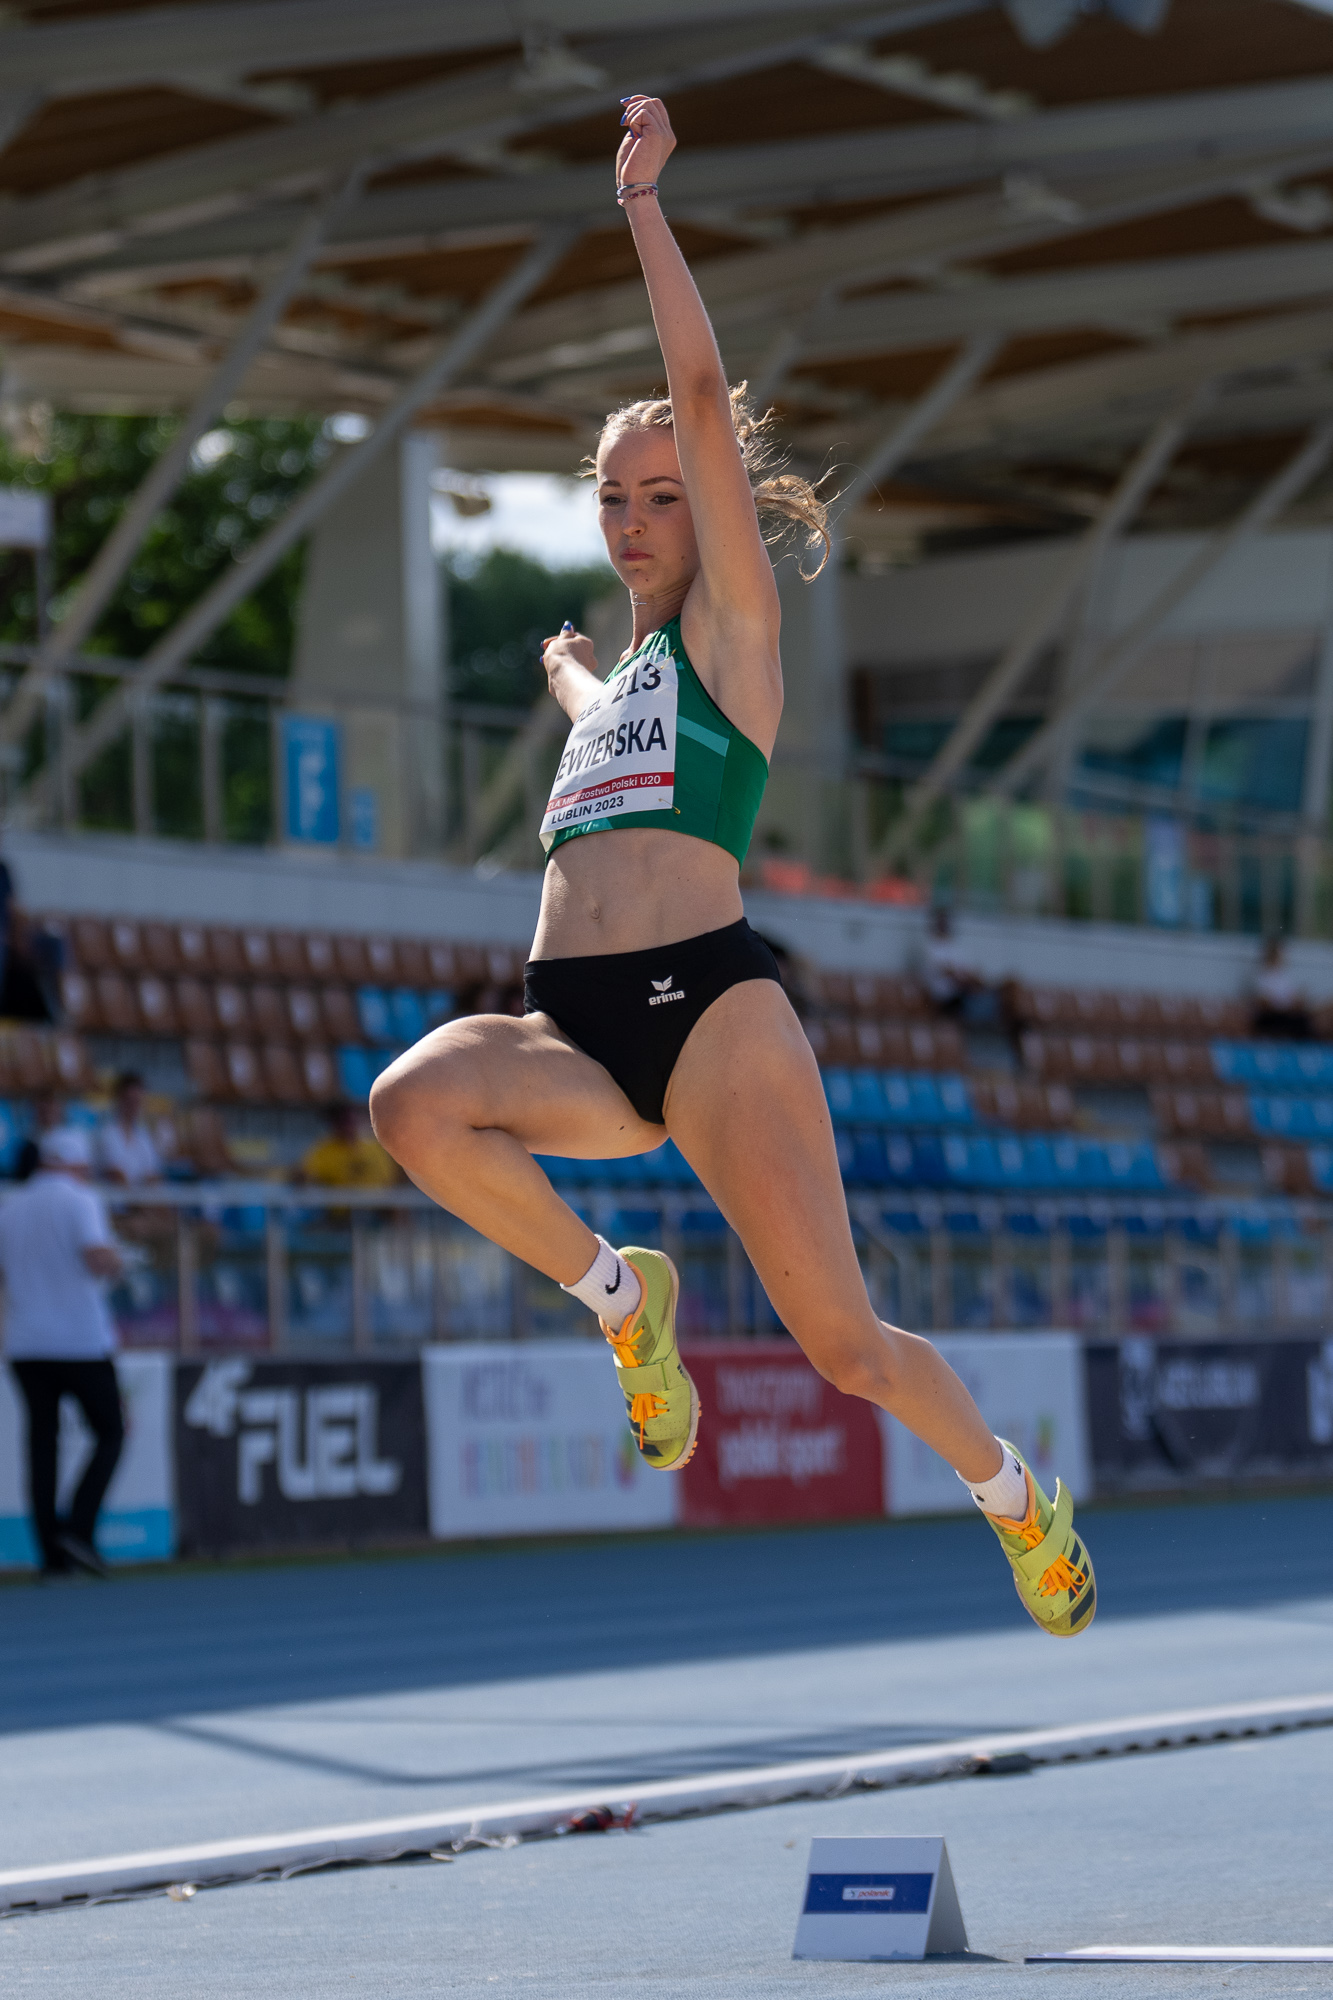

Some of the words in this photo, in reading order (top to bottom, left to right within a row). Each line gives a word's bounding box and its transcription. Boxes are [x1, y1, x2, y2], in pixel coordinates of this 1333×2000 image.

[611, 662, 662, 705] 213
[562, 785, 610, 806] Mistrzostwa
[611, 776, 638, 791] Polski
[640, 775, 661, 786] U20
[551, 805, 592, 825] LUBLIN
[594, 795, 624, 813] 2023
[648, 989, 685, 1006] erima
[857, 1889, 890, 1900] polanik
